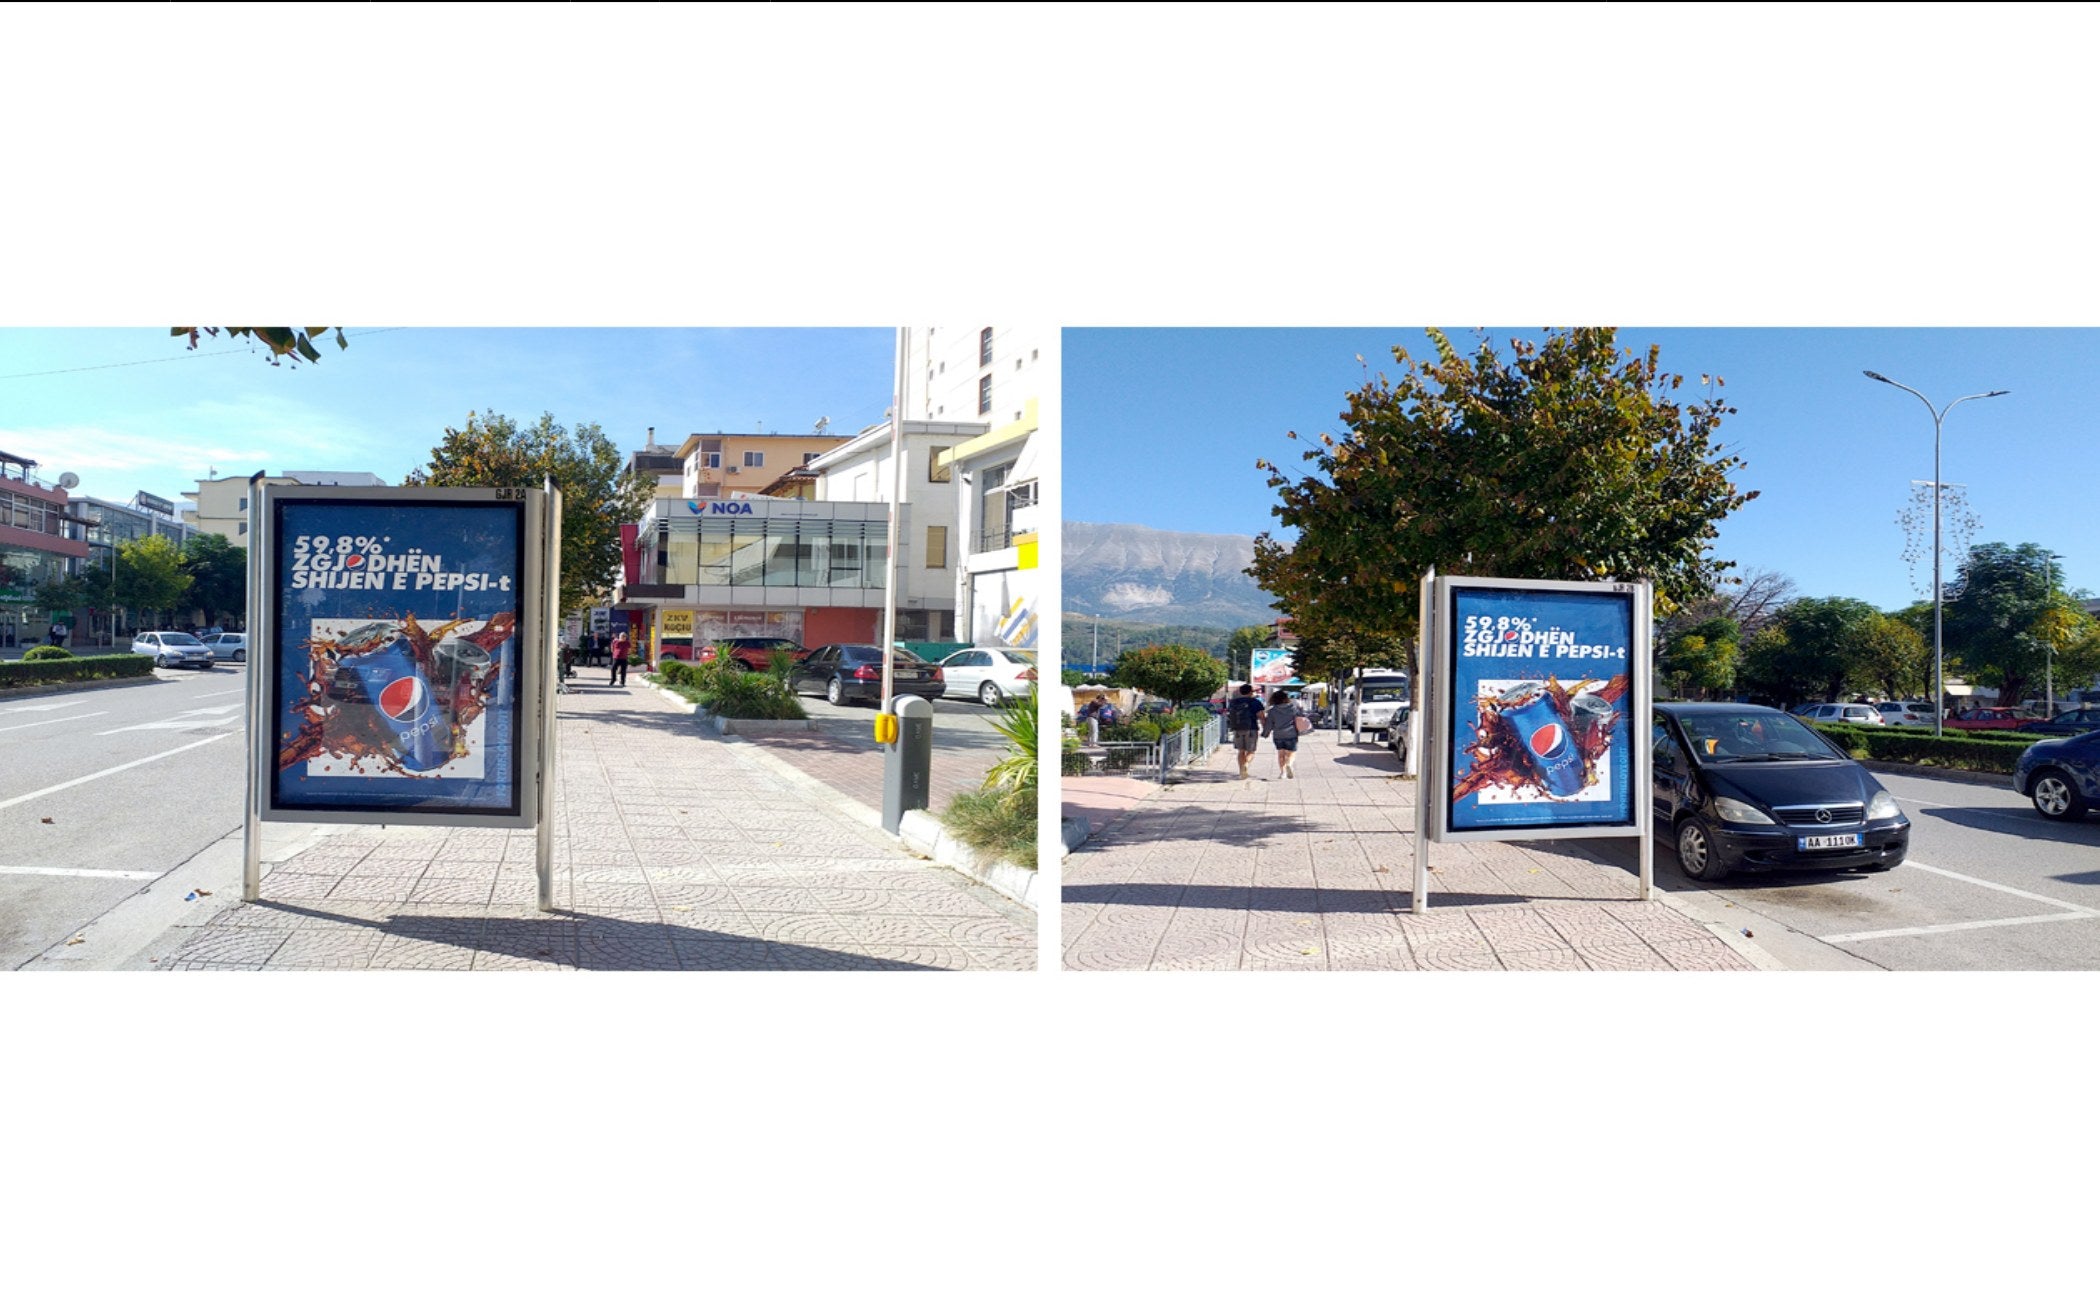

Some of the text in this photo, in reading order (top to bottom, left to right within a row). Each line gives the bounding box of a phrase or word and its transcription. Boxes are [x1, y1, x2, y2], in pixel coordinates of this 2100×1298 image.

[712, 502, 753, 515] NOA
[291, 571, 512, 592] SHIJEN E PEPSI-t
[1462, 643, 1626, 659] SHIJEN E PEPSI-t
[400, 713, 441, 742] pepsi
[1546, 753, 1574, 775] pepsi
[1808, 837, 1821, 848] AA
